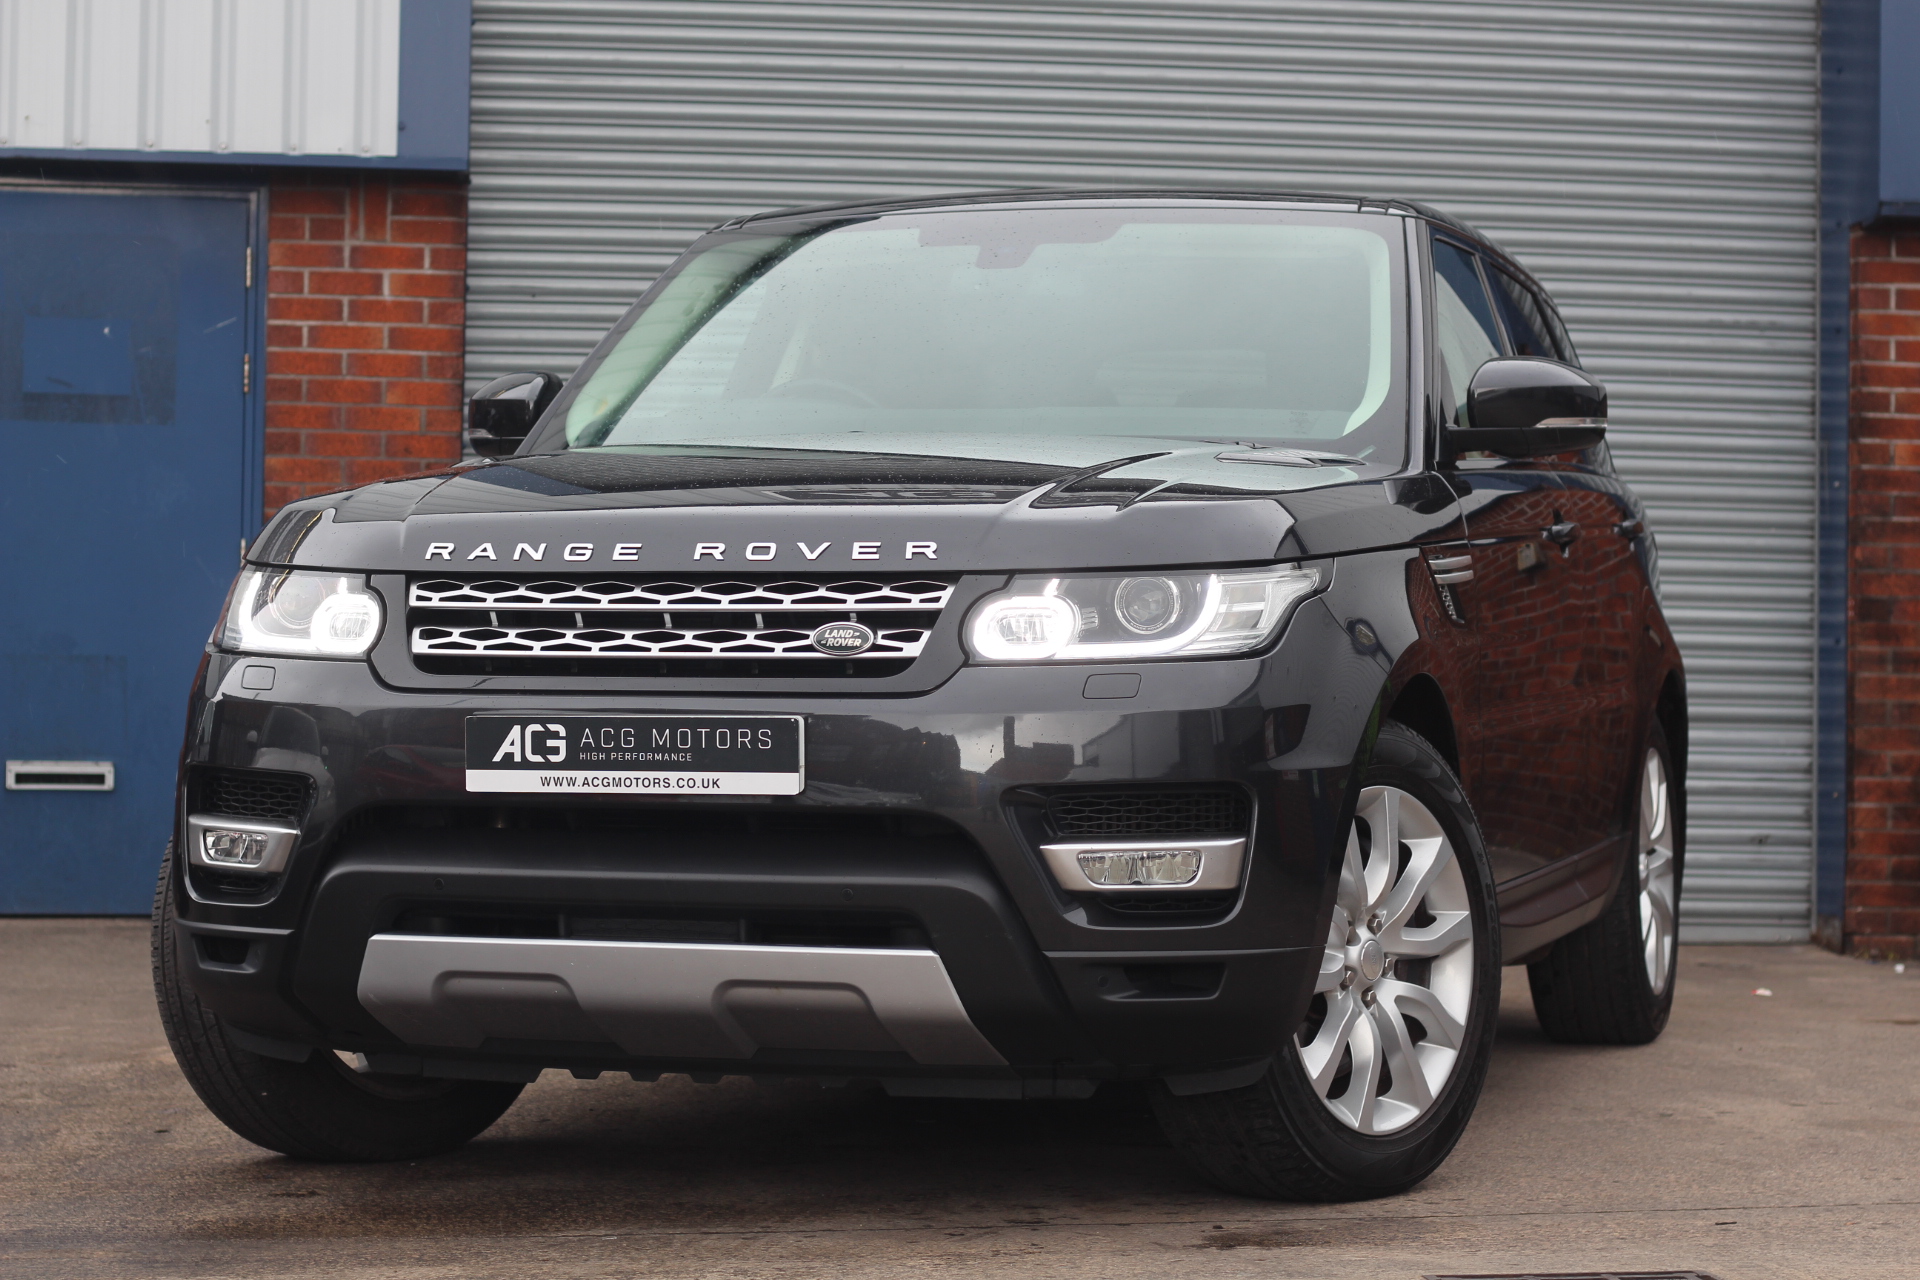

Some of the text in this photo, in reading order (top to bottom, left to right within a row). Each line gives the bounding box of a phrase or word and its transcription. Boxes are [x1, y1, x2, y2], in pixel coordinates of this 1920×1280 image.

[425, 541, 938, 561] RANGE ROVER
[824, 629, 853, 637] LAND
[826, 638, 861, 646] ROVER
[492, 723, 566, 762] ACG
[580, 728, 772, 749] ACG MOTORS
[580, 752, 692, 761] HIGH PERFORMANCE
[540, 776, 720, 788] WWW.ACGMOTORS.CO.UK
